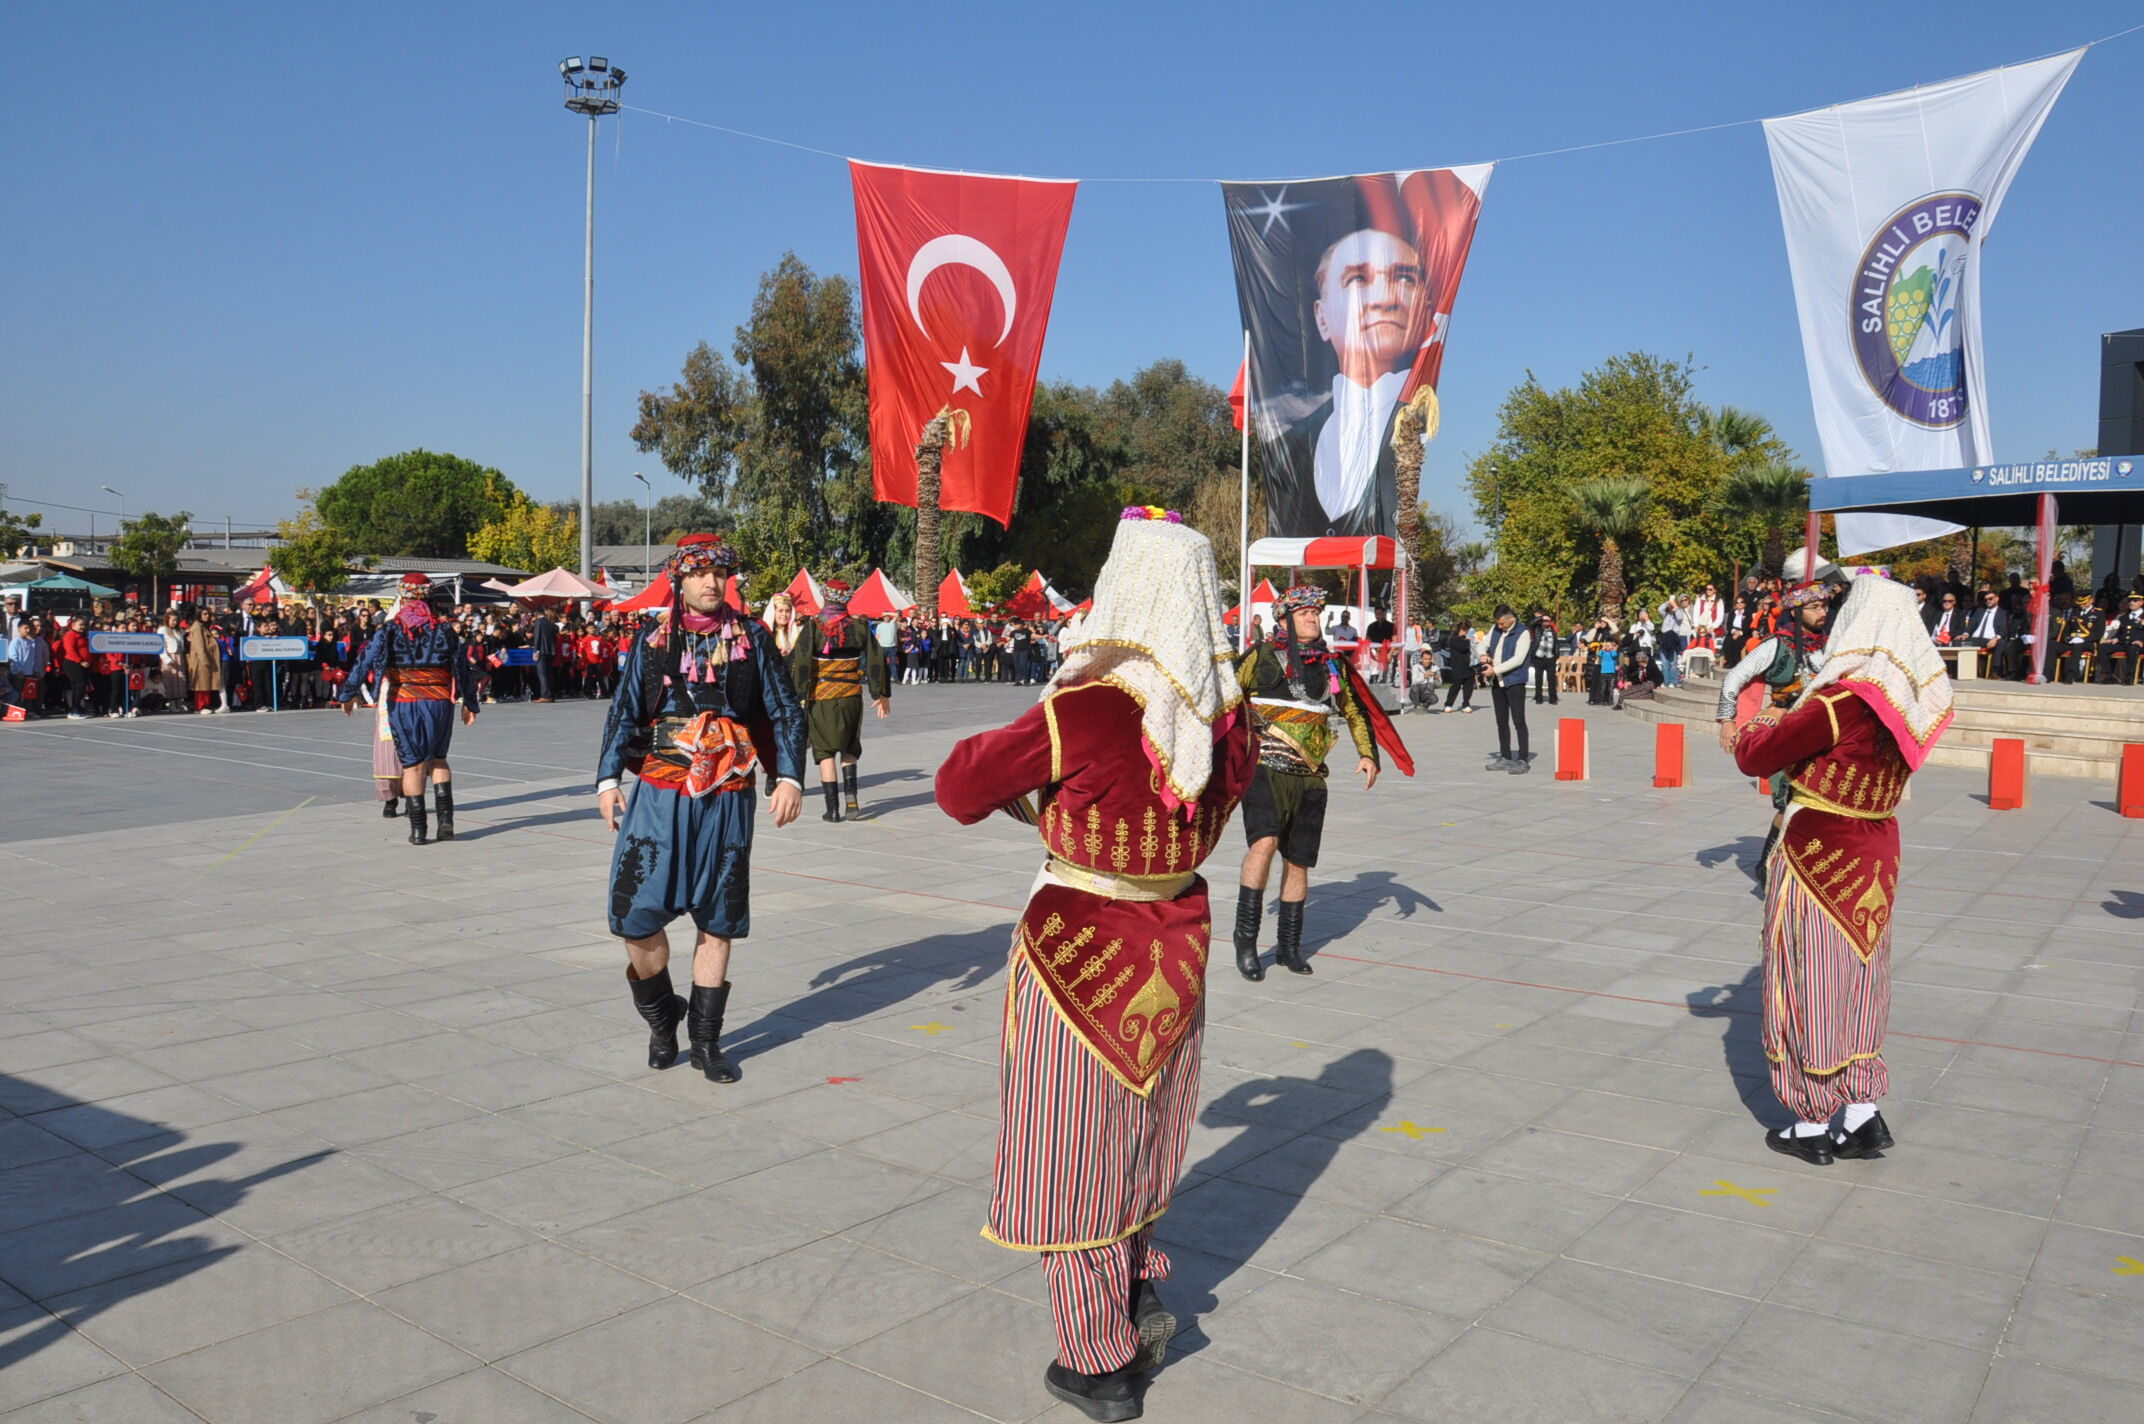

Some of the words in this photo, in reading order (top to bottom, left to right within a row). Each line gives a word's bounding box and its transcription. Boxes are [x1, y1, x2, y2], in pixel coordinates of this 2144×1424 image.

[1862, 226, 1911, 334] SALİHLİ
[1989, 463, 2034, 486] SALİHLİ
[2036, 457, 2111, 482] BELEDİYESİ
